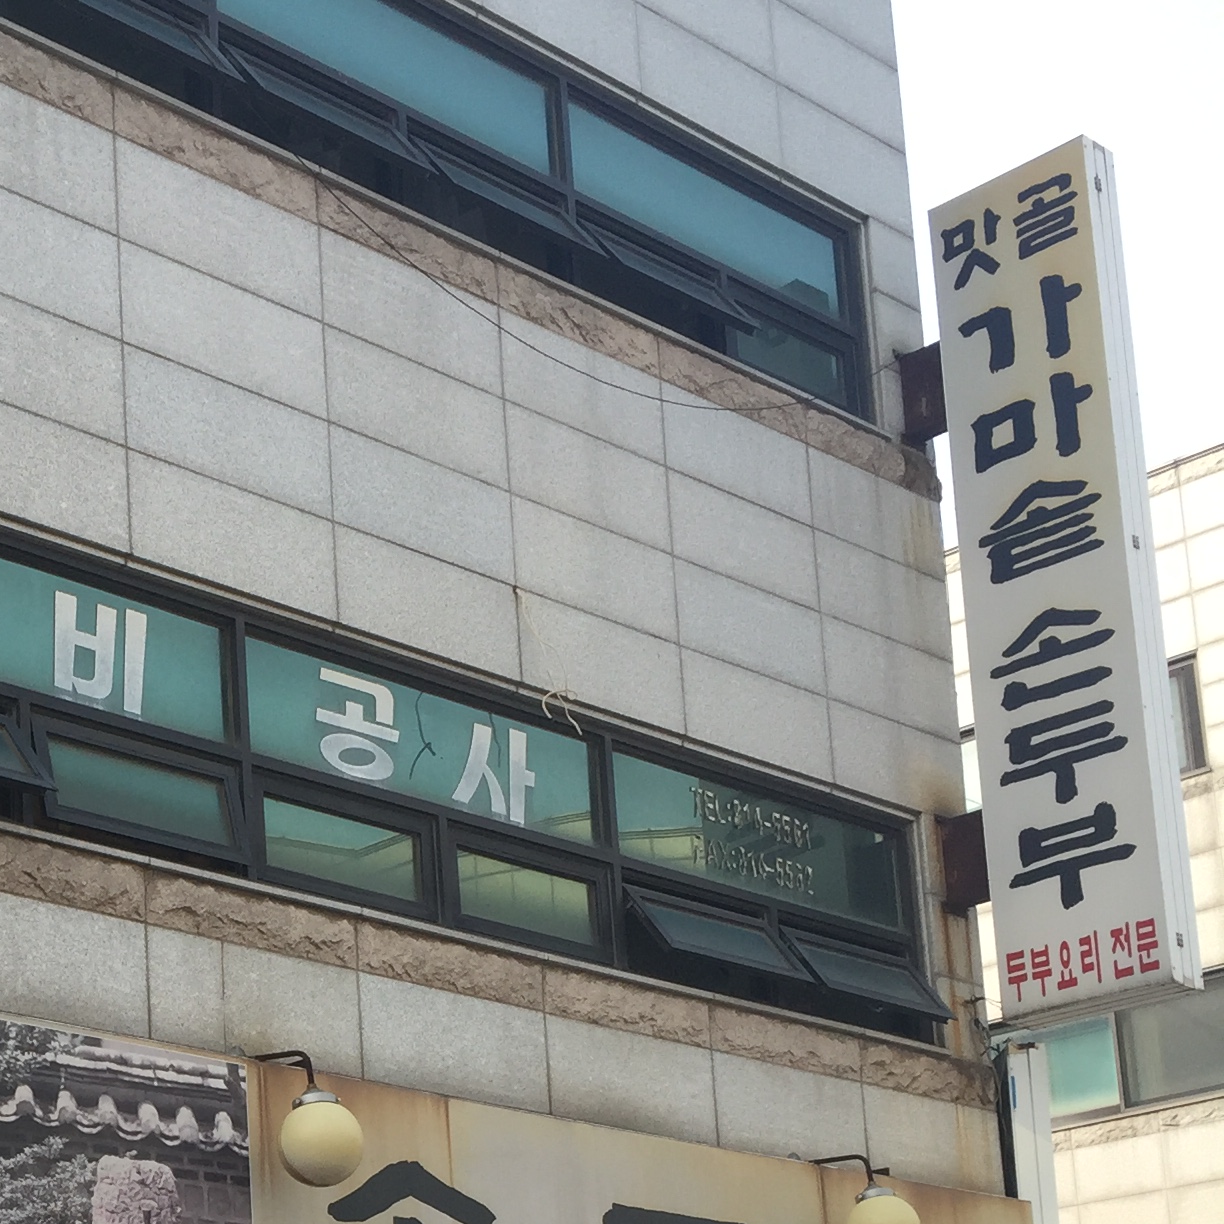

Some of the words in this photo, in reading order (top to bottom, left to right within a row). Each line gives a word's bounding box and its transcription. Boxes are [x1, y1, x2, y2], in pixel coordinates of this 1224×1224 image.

[940, 172, 1079, 291] 맛골
[1005, 929, 1104, 1003] 두부요리
[1109, 917, 1162, 980] 전문
